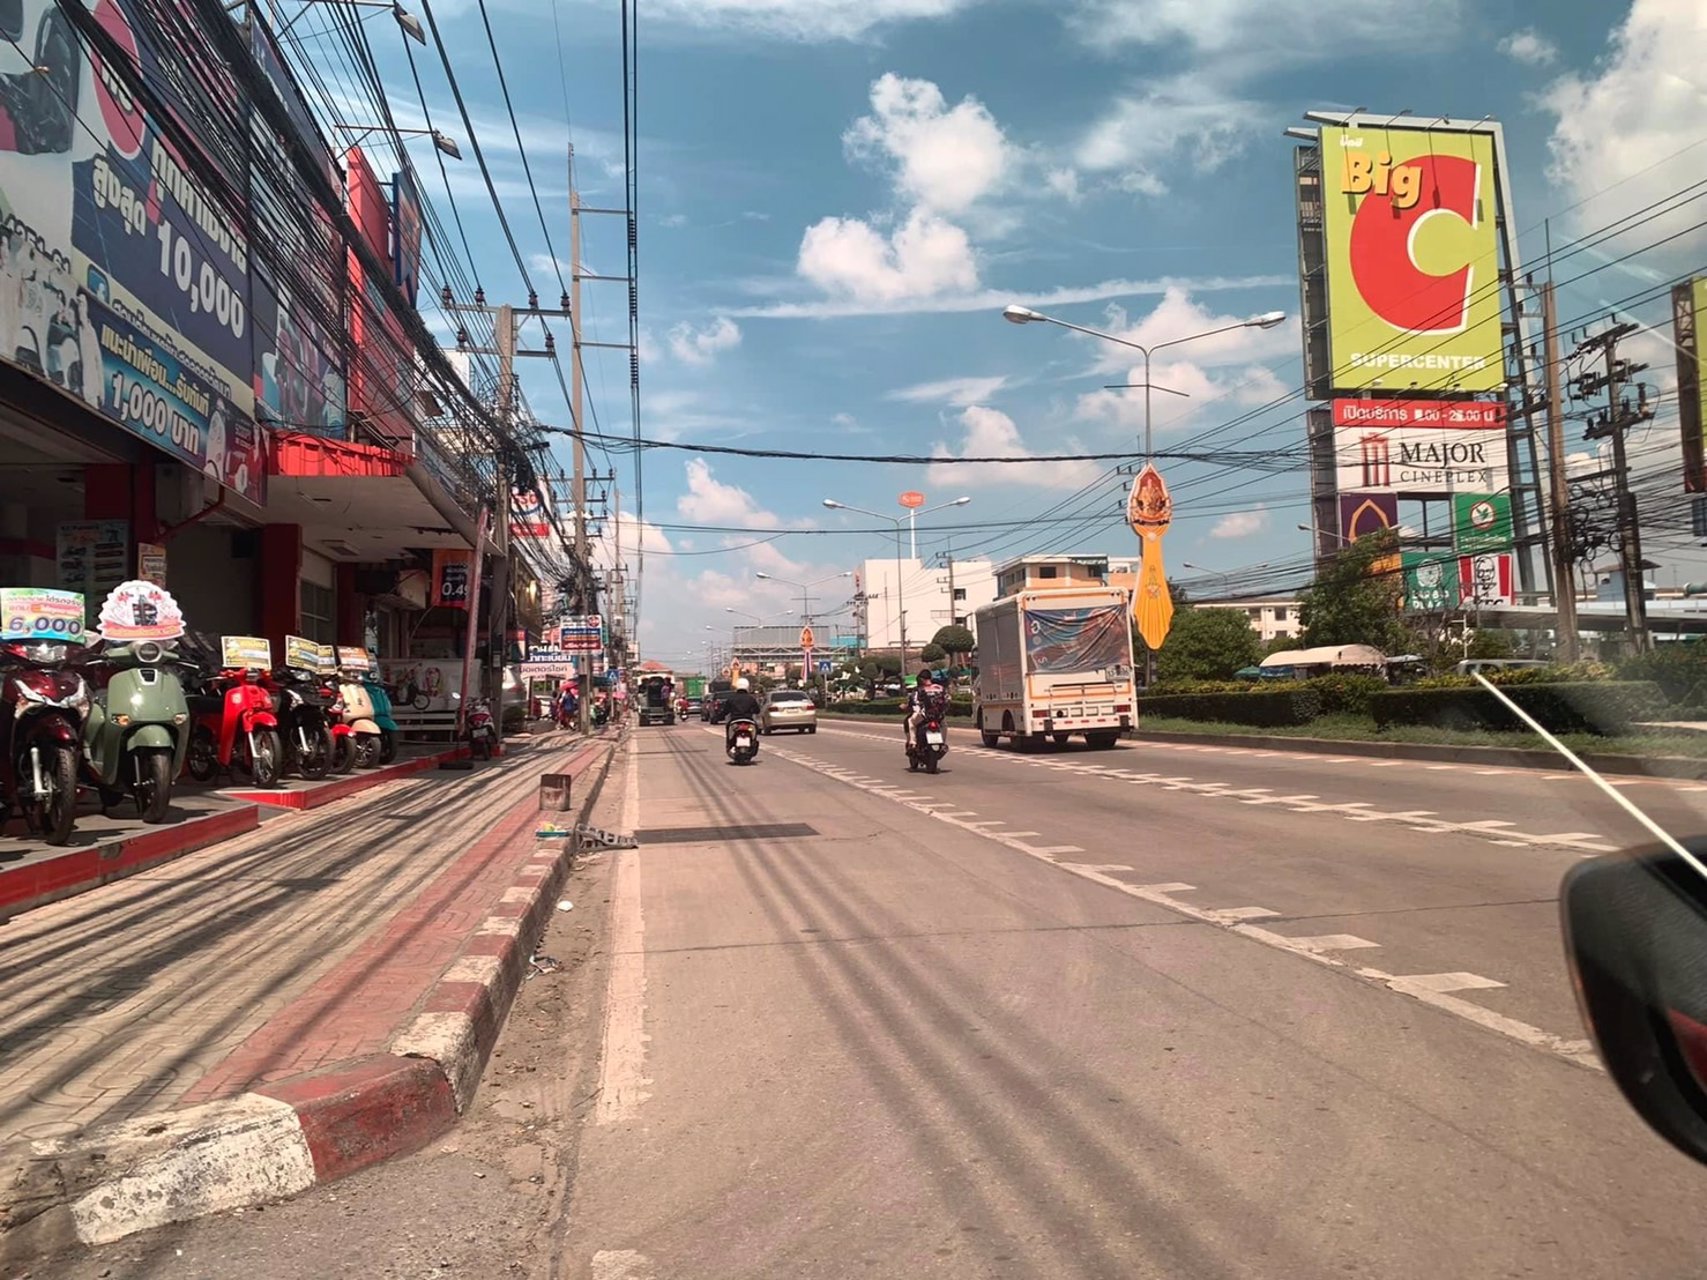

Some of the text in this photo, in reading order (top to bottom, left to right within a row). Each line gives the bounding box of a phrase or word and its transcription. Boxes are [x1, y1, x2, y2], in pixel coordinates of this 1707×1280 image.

[1341, 152, 1482, 335] Big C
[157, 219, 244, 338] 10,000
[1350, 352, 1486, 370] SUPERCENTER
[113, 373, 167, 435] 1,000
[170, 407, 200, 454] บาท
[1400, 442, 1486, 469] MAJOR
[1400, 470, 1487, 483] CINEPLEX
